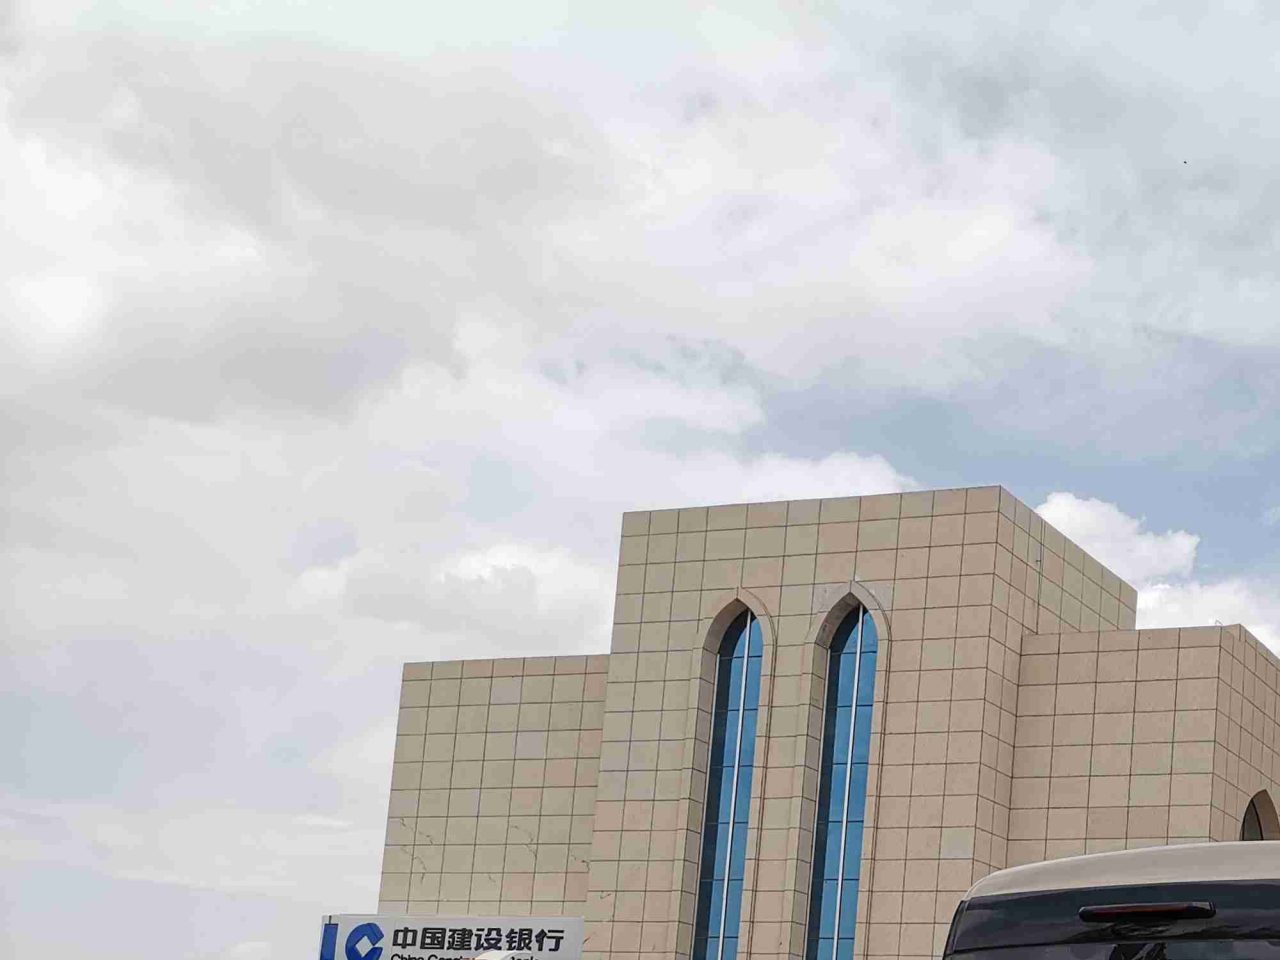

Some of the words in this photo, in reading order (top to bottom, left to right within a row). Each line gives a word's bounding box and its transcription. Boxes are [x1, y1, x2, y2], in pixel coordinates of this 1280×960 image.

[392, 926, 565, 951] 中国建设银行
